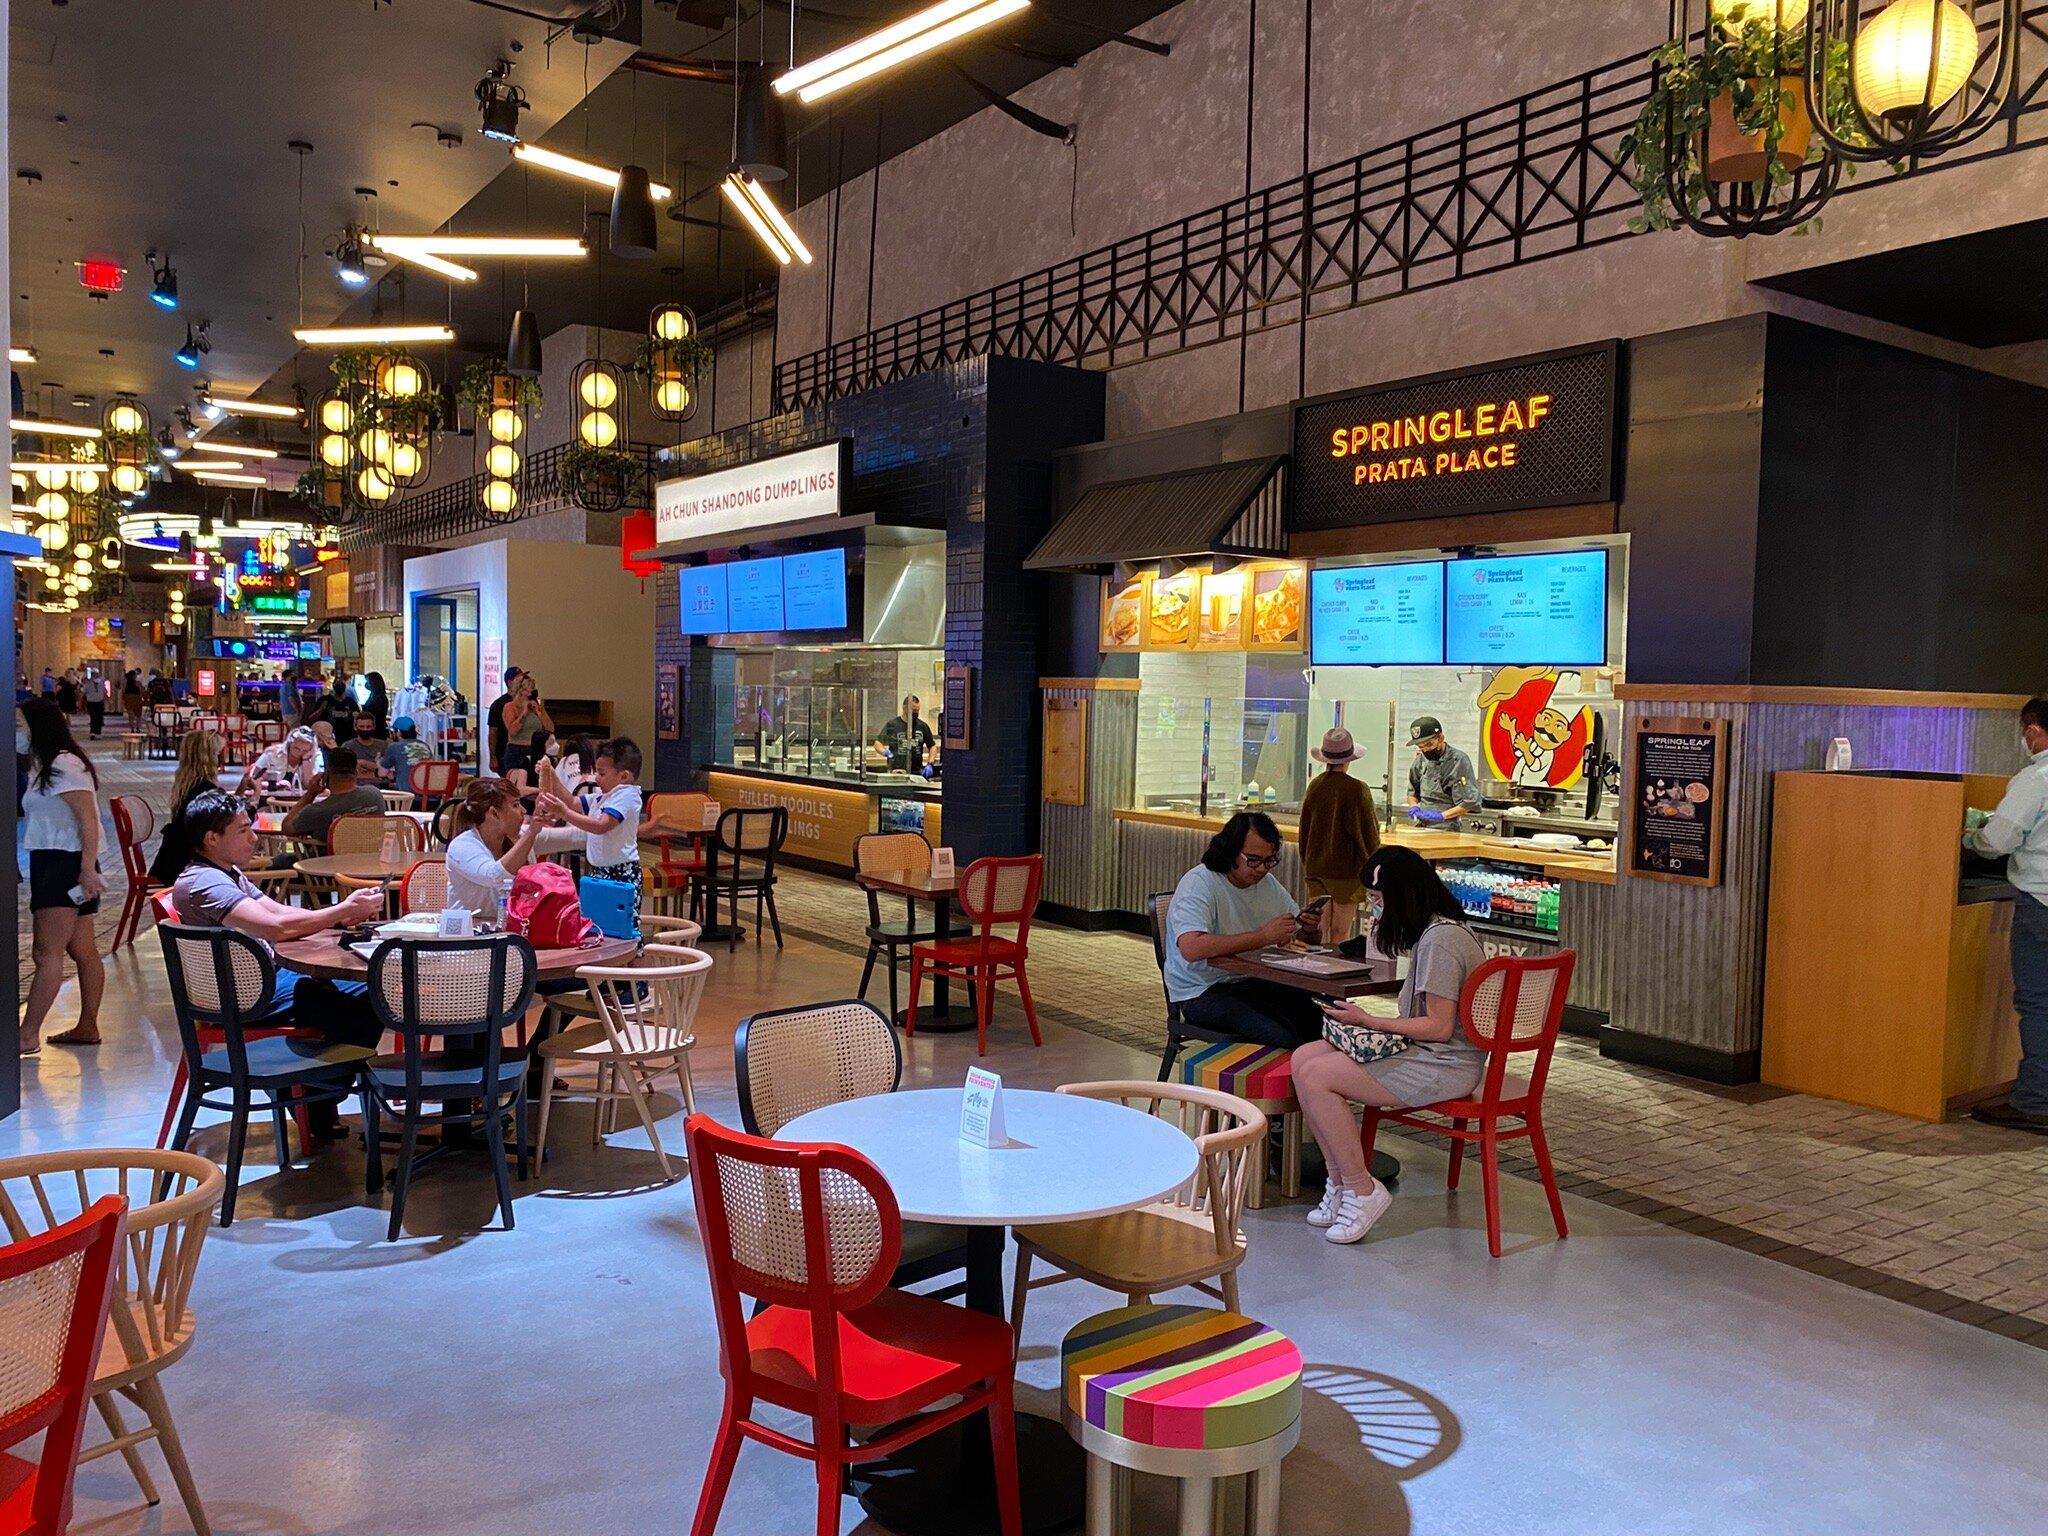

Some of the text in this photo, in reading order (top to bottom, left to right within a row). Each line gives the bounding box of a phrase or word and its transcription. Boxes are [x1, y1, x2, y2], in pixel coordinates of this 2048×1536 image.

[1331, 394, 1550, 458] SPRINGLEAF
[1354, 443, 1517, 486] PRATA PLACE
[659, 472, 836, 523] AH CHUN SHANDONG DUMPLINGS
[1648, 737, 1711, 747] SPRINGLEAF
[739, 789, 834, 820] PULLED NOODLES
[787, 818, 820, 840] LINGS
